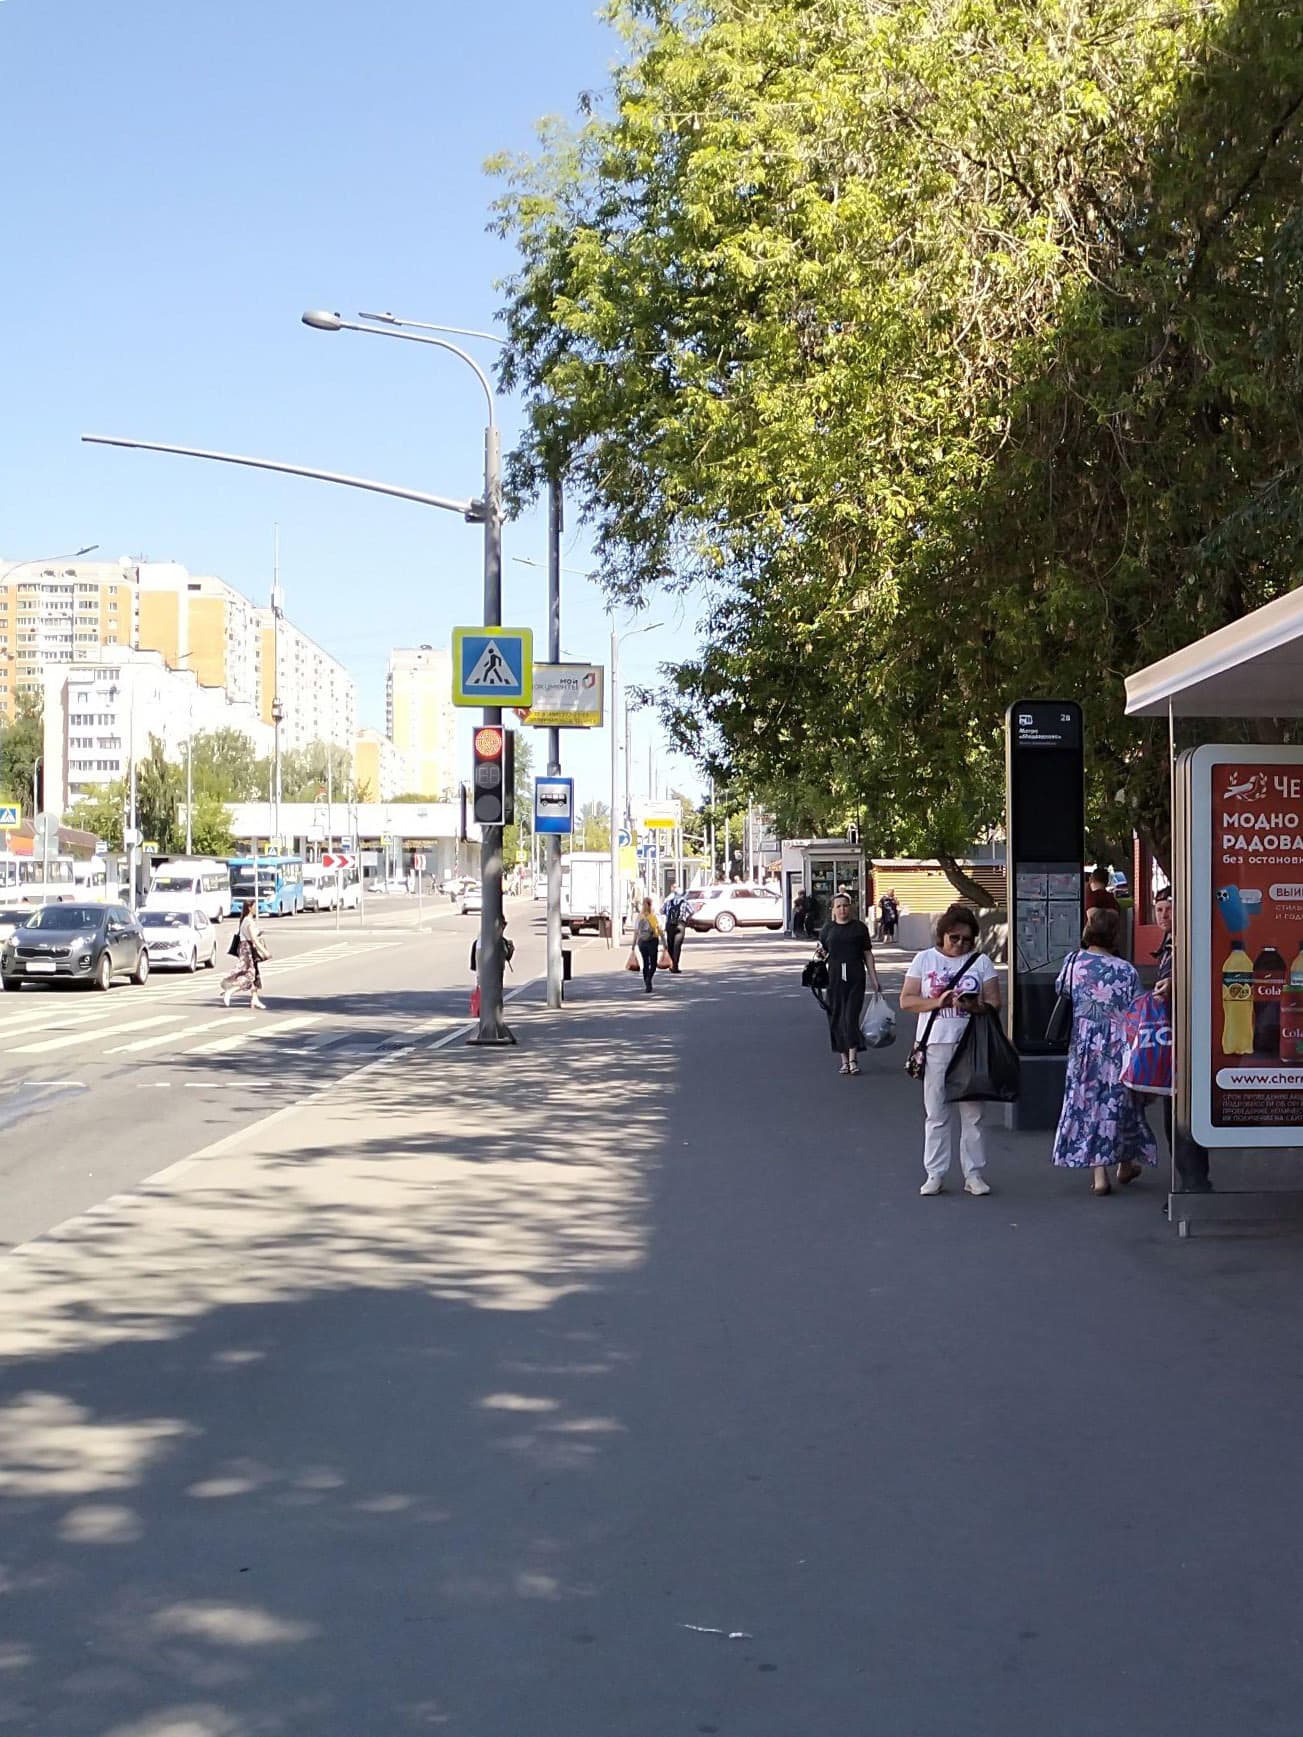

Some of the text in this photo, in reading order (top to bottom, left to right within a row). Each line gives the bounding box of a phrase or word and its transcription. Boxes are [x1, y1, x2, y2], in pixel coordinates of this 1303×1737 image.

[1222, 812, 1299, 830] МОДНО
[1222, 854, 1243, 864] без
[1257, 985, 1282, 996] Cola
